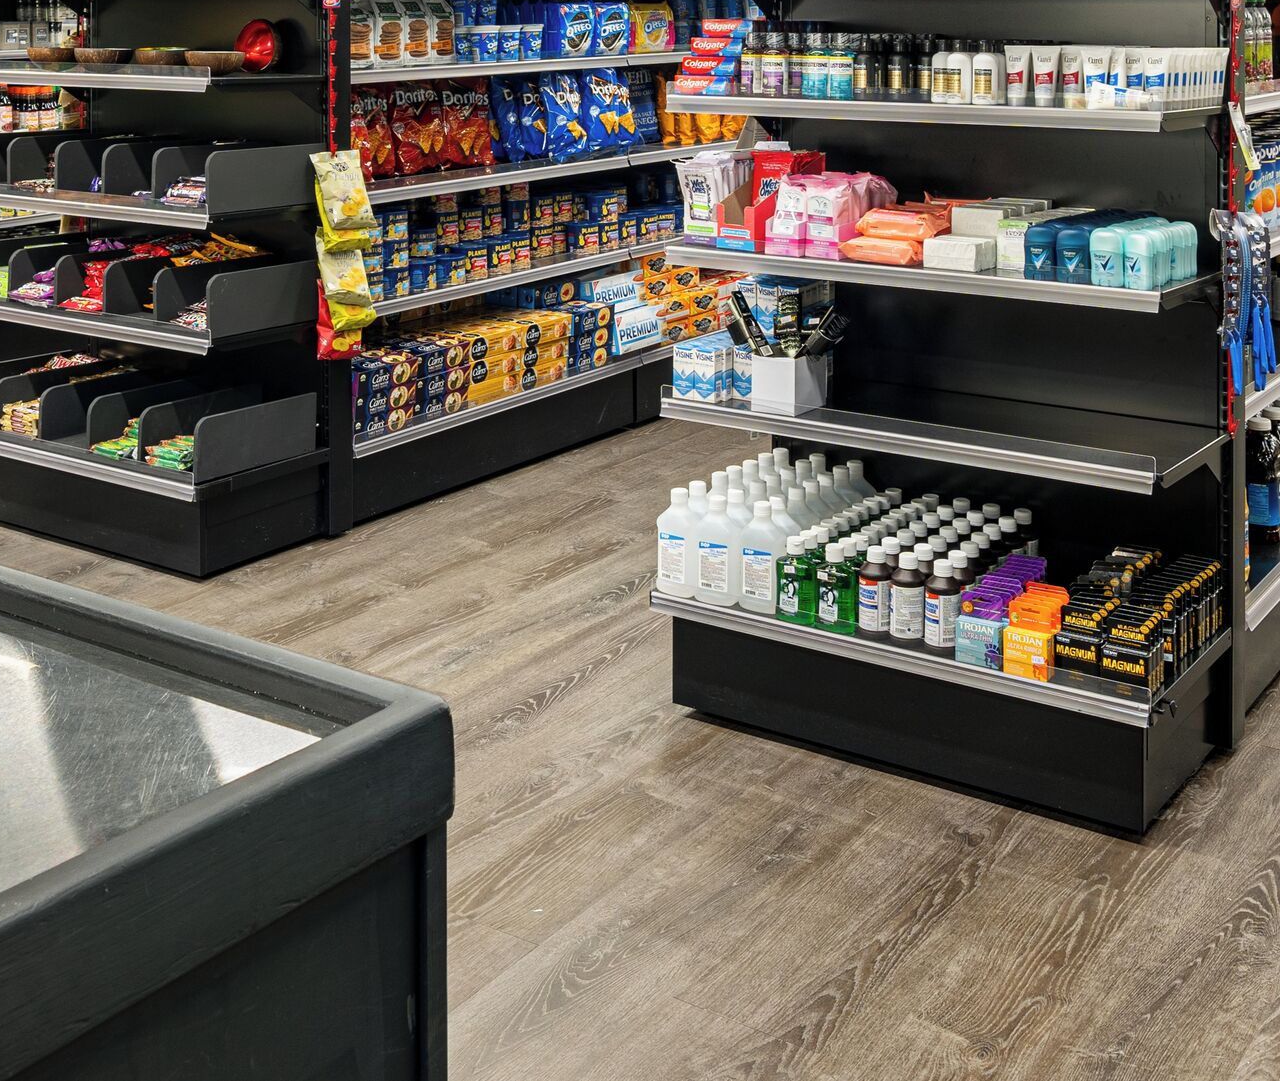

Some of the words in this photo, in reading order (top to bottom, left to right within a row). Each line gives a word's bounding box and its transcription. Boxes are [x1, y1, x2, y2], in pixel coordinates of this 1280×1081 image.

[566, 23, 591, 37] OREO
[600, 23, 626, 37] OREO
[644, 20, 666, 34] OREO
[704, 22, 737, 33] Colgate
[693, 40, 726, 50] Colgate
[684, 59, 718, 69] Colgate
[675, 78, 710, 88] Colgate
[395, 88, 437, 106] Doritos
[442, 90, 489, 107] Doritos
[691, 179, 705, 189] Wet
[691, 185, 706, 195] Ones
[761, 178, 777, 191] Wet
[594, 283, 636, 303] PREMIUM
[738, 285, 756, 293] VISINE
[758, 288, 777, 296] VISINE
[619, 322, 659, 342] PREMIUM
[471, 342, 487, 353] Carr's
[427, 355, 444, 367] Carr's
[674, 349, 694, 360] VISINE
[695, 352, 715, 362] VISINE
[471, 365, 487, 377] Carr's
[371, 372, 390, 385] Carr's
[428, 378, 445, 390] Carr's
[368, 395, 387, 408] Carr's
[425, 403, 443, 416] Carr's
[367, 419, 385, 431] Carr's
[1065, 614, 1097, 628] MAGNUM
[959, 621, 994, 636] TROJAN
[1111, 628, 1145, 641] MAGNUM
[1006, 632, 1043, 646] TROJAN
[1056, 644, 1096, 661] MAGNUM
[1103, 656, 1145, 675] MAGNUM
